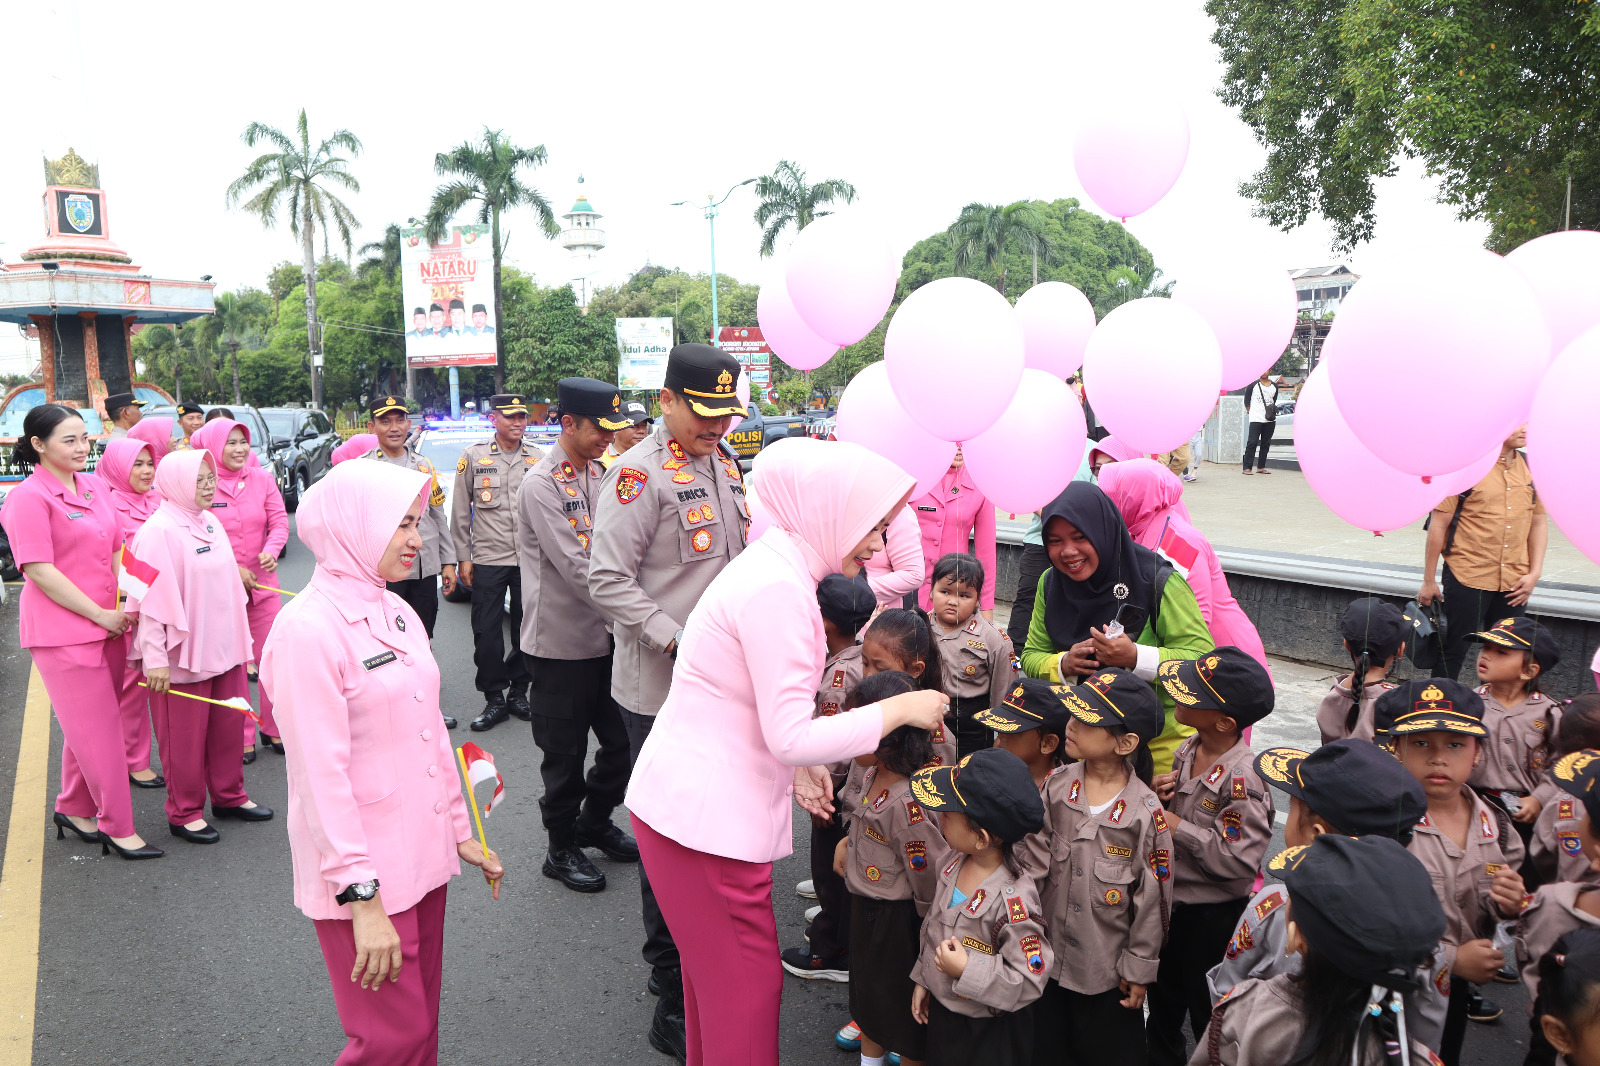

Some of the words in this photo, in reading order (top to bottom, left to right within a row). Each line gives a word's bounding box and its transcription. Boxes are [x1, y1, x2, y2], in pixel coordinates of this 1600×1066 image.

[420, 260, 476, 277] NATARU
[431, 284, 465, 300] 2025
[624, 346, 641, 354] Idul
[644, 345, 667, 353] Adha
[726, 430, 762, 443] POLISI
[677, 487, 709, 502] ERICK
